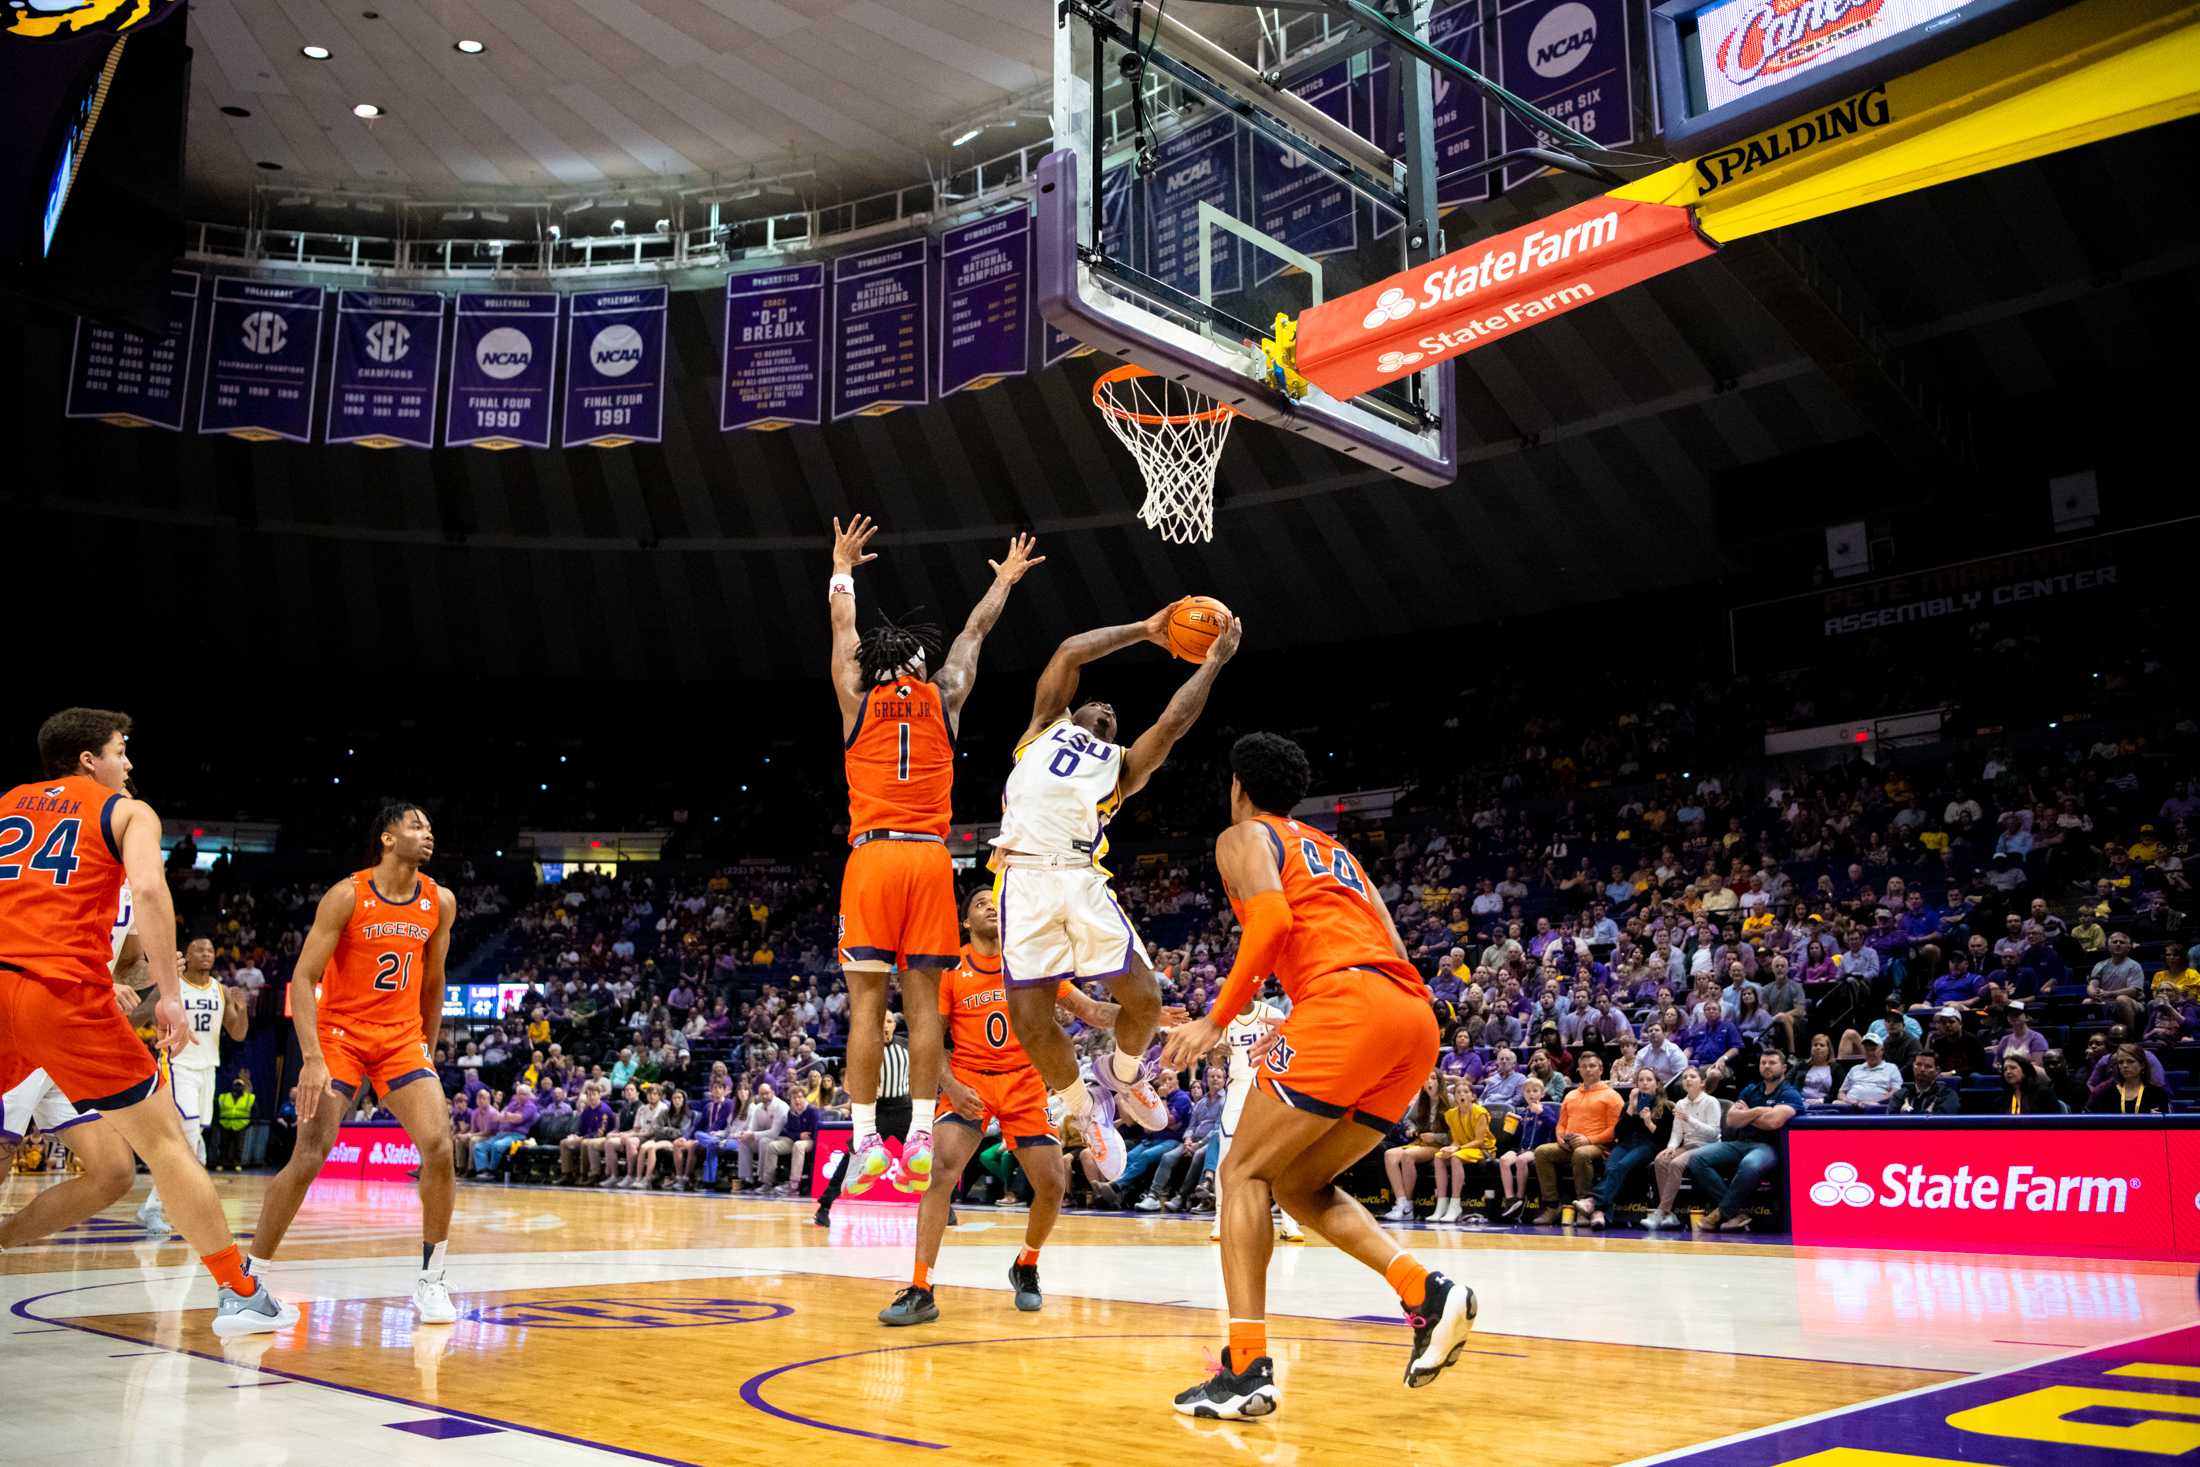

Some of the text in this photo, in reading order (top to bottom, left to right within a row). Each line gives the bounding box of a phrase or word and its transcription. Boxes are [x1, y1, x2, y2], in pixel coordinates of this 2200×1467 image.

[1536, 28, 1594, 67] NCAA
[1543, 88, 1601, 119] PER SIX
[1537, 110, 1598, 149] 208
[1695, 81, 1890, 197] SPALDING
[1166, 157, 1211, 194] NCAA
[957, 260, 1013, 288] CHAMPIONS
[962, 251, 1007, 274] NATIONAL
[851, 290, 909, 313] CHAMPIONS
[856, 281, 902, 301] NATIONAL
[241, 311, 289, 355] SEC
[366, 319, 411, 363] SEC
[742, 320, 806, 343] BREAUX
[482, 352, 531, 366] NCAA
[596, 349, 641, 365] NCAA
[357, 367, 414, 380] CHAMPIONS
[469, 397, 532, 410] FINAL FOUR
[584, 394, 644, 409] FINAL FOUR
[477, 410, 522, 428] 1990
[595, 408, 632, 427] 1991
[1824, 565, 2118, 636] ASSEMBLY CENTER
[1190, 611, 1219, 627] ELIT
[874, 701, 912, 719] GREEN
[898, 722, 910, 781] 1
[1050, 728, 1113, 761] LSU
[1049, 748, 1081, 777] 0
[0, 815, 82, 886] 24
[363, 921, 430, 945] TIGERS
[373, 951, 414, 992] 21
[184, 998, 219, 1011] LSU
[963, 989, 1008, 1010] TIGE
[194, 1013, 212, 1032] 12
[985, 1010, 1009, 1049] 0
